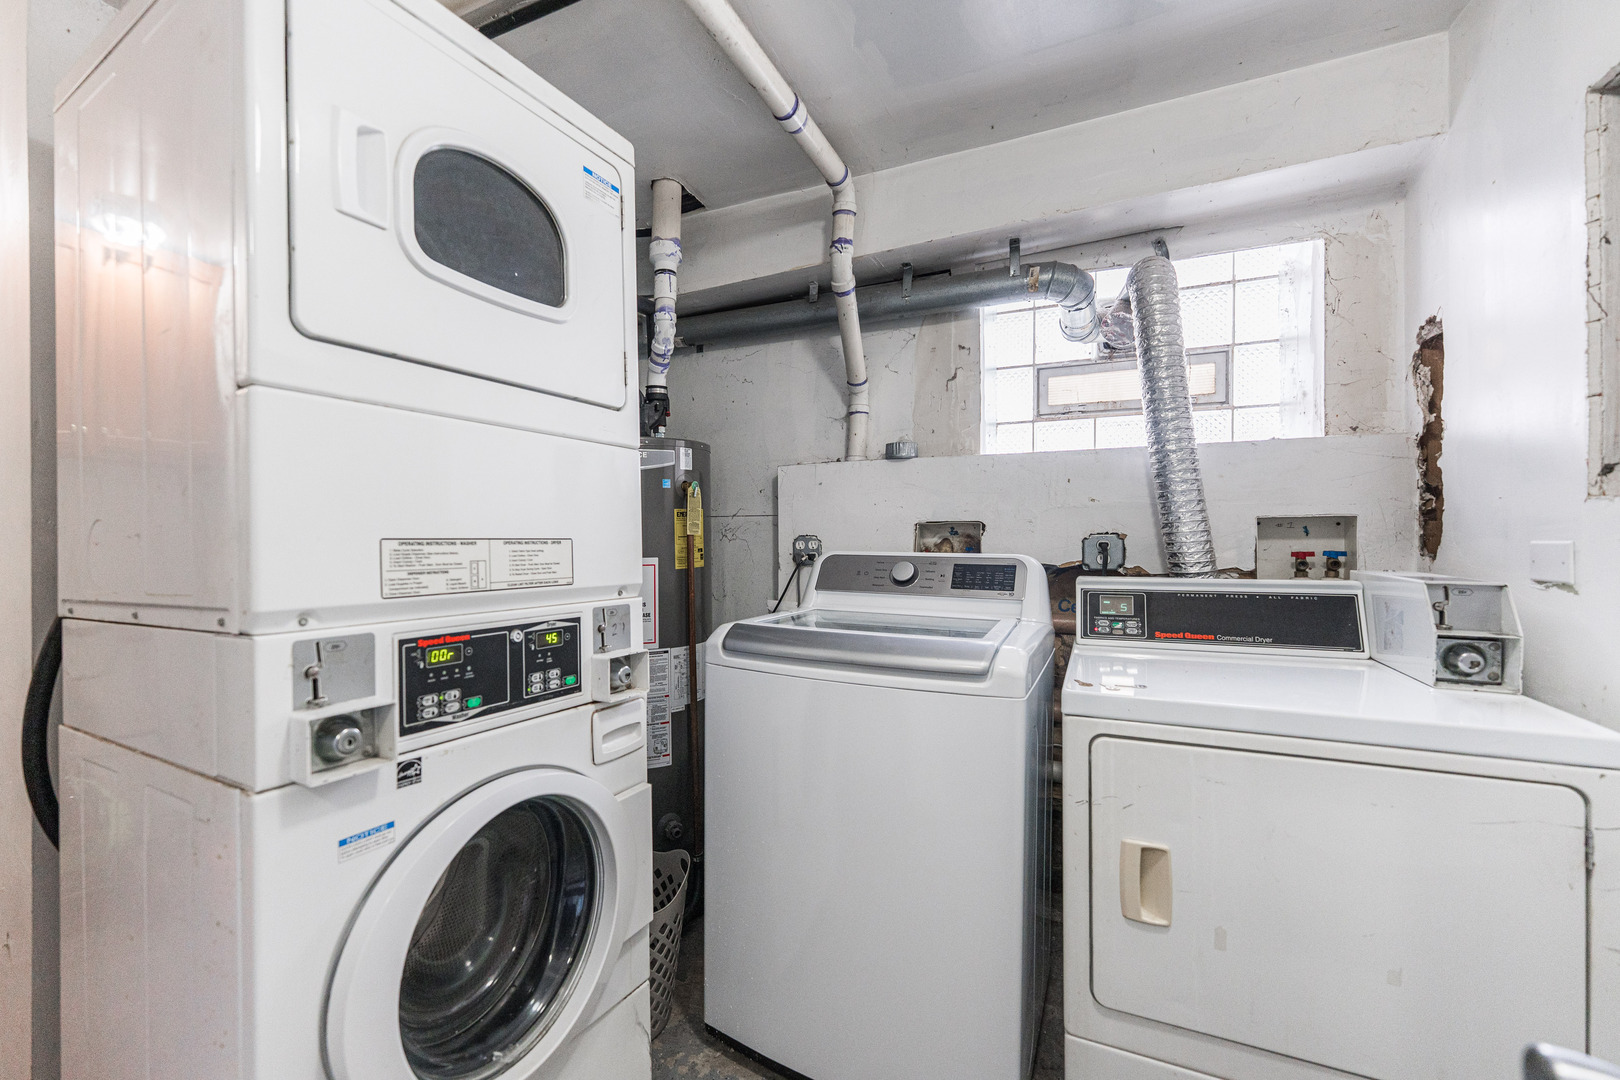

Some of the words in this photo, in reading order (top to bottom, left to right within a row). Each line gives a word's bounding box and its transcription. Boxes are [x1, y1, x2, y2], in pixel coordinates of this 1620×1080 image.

[417, 636, 444, 648] Speed
[445, 634, 471, 644] Queen
[546, 632, 558, 644] 45
[1154, 631, 1183, 639] Speed
[1184, 632, 1215, 640] Queen
[1216, 634, 1254, 642] Commercial
[1254, 635, 1273, 644] Dryer
[346, 824, 388, 844] NOTICE
